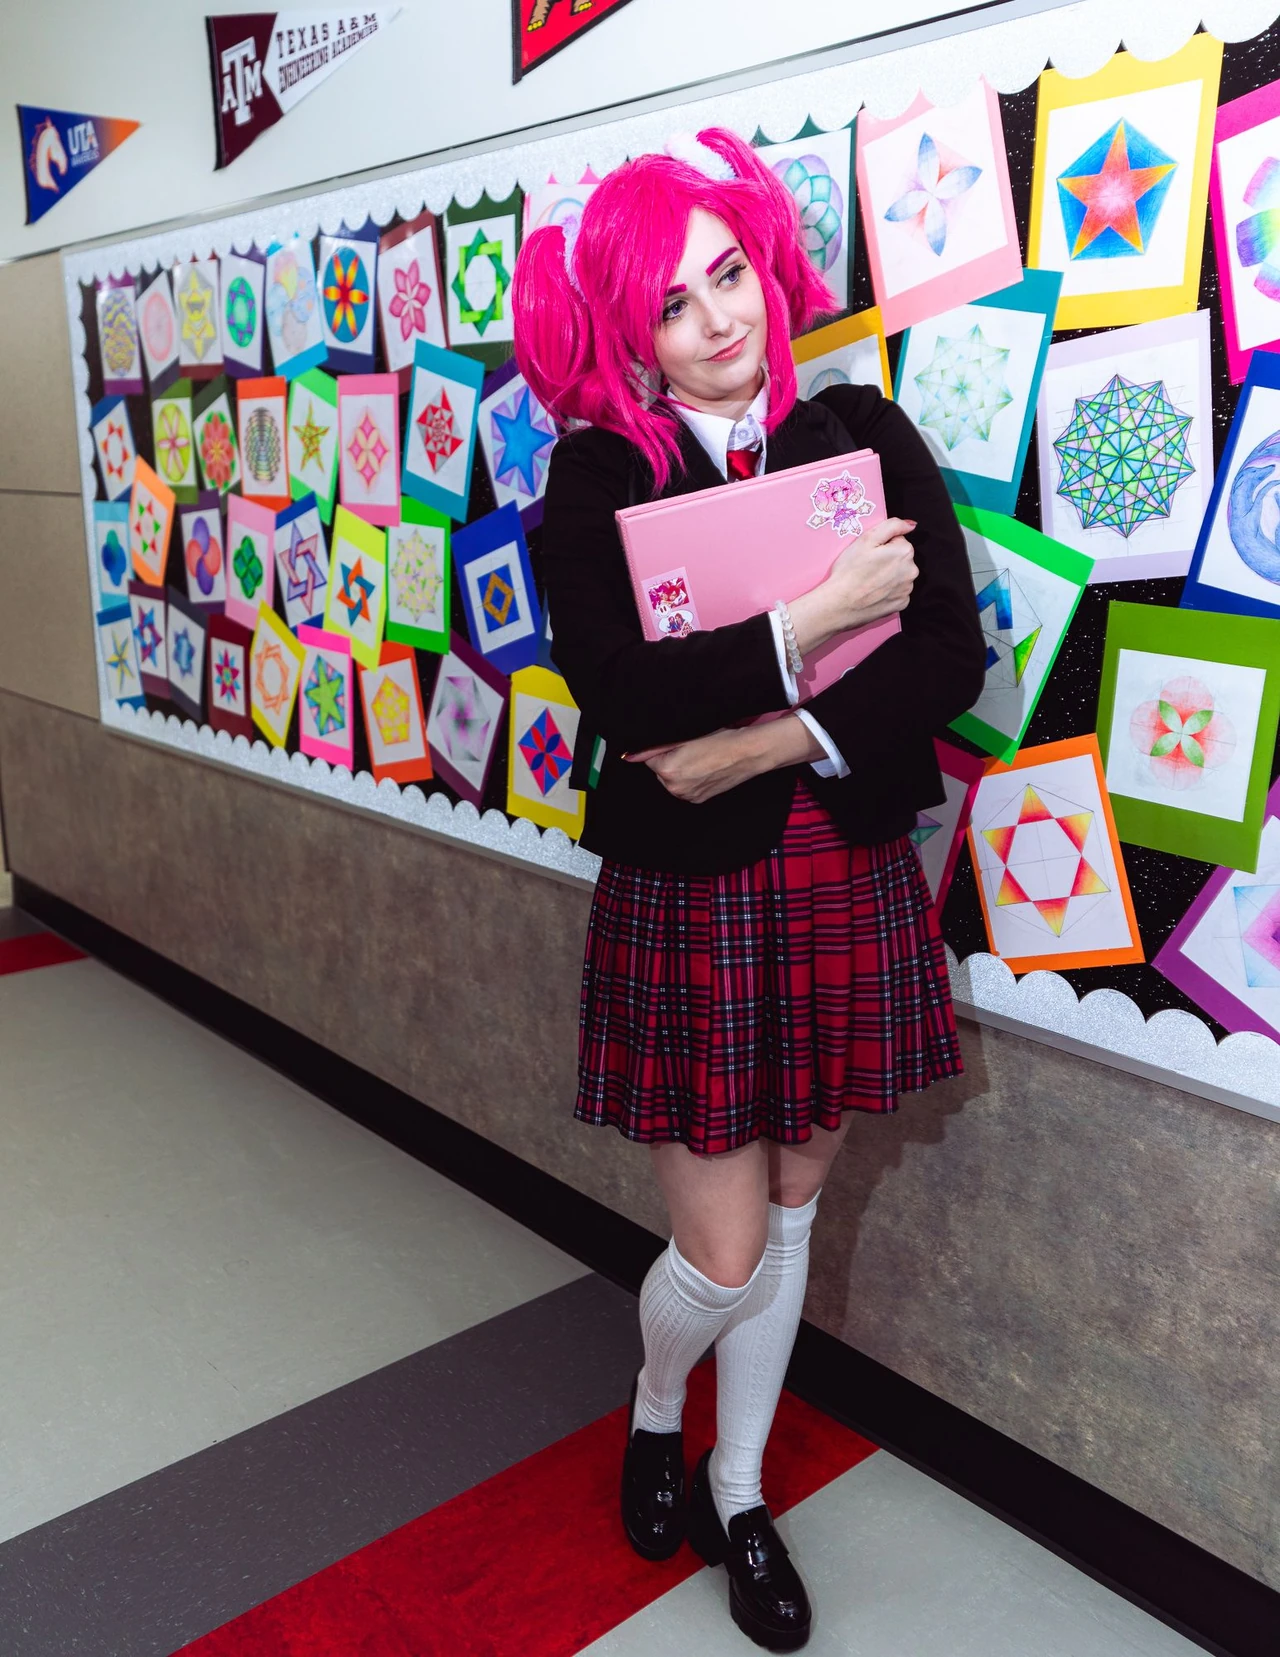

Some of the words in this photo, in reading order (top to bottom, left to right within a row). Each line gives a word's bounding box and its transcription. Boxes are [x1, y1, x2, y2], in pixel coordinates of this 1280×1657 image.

[276, 23, 329, 58] TEXAS
[278, 46, 329, 94] ENGINEERING
[332, 21, 379, 58] ACADEMIES
[67, 120, 98, 155] UTA
